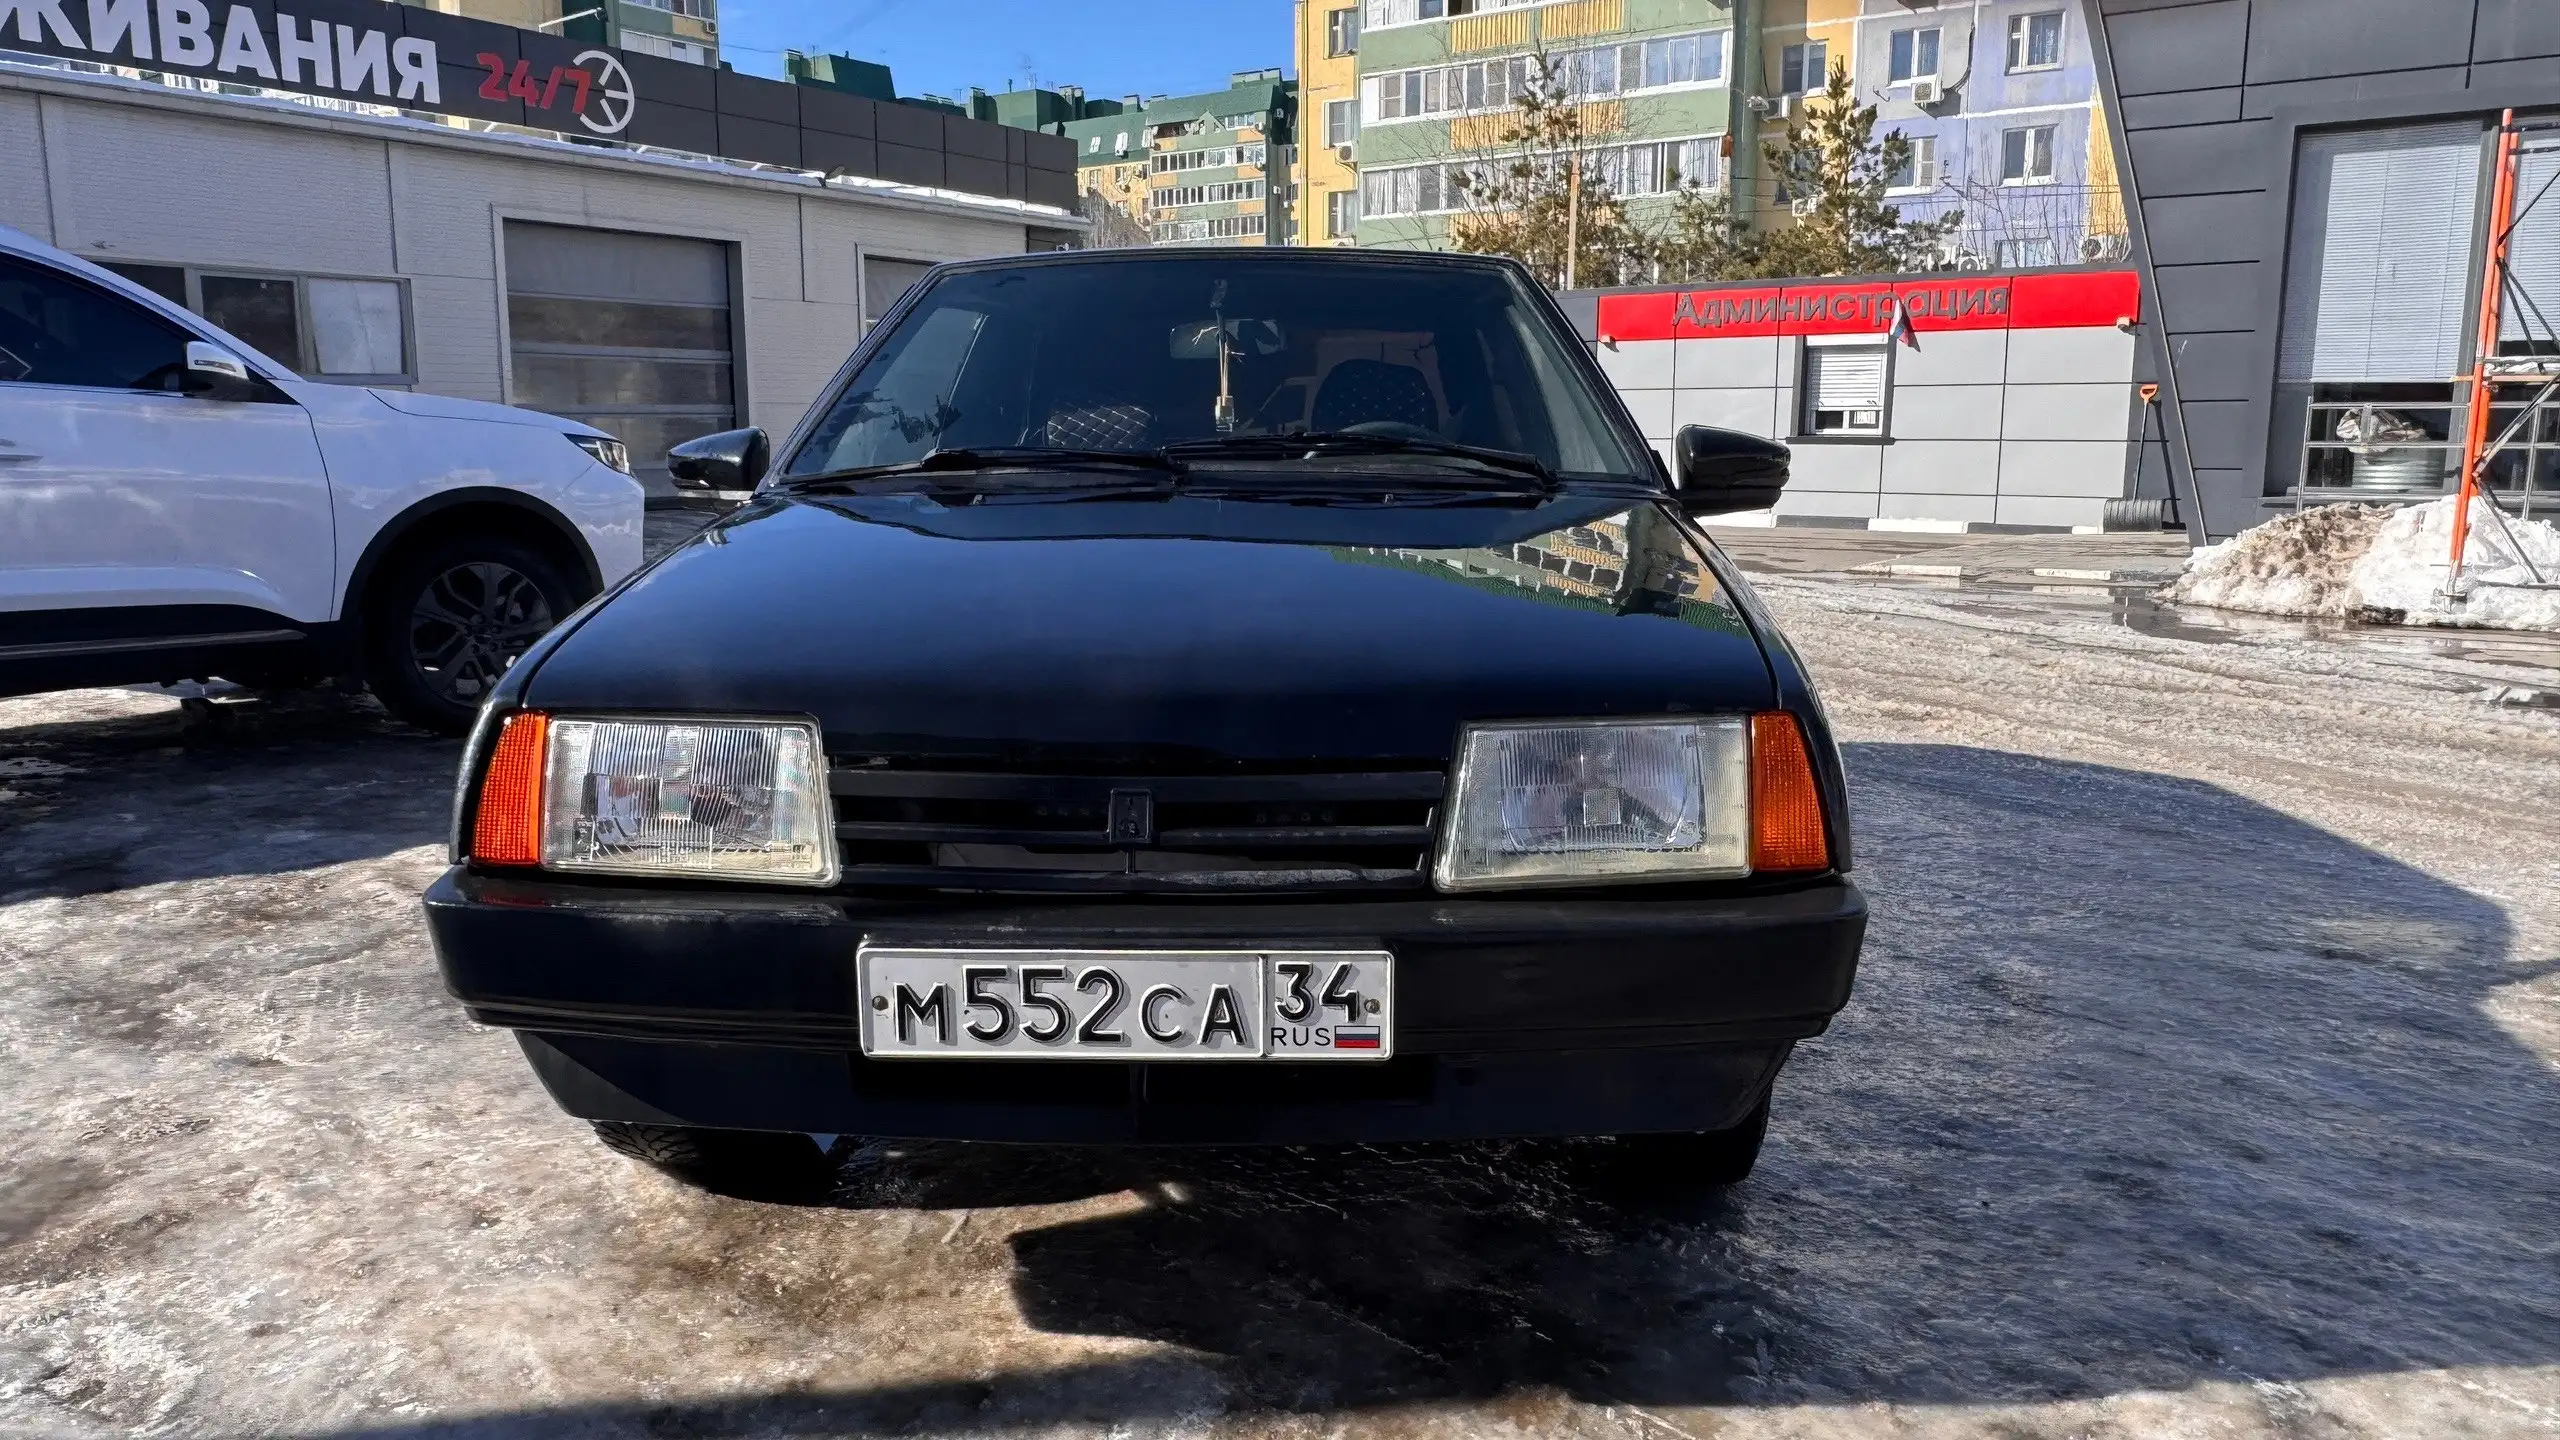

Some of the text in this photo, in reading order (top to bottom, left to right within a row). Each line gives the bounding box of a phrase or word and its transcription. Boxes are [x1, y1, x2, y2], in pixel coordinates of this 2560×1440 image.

[476, 52, 591, 115] 24/7
[1673, 286, 2009, 327] Администрация
[1275, 961, 1360, 1023] 34
[1270, 1026, 1331, 1047] RUS
